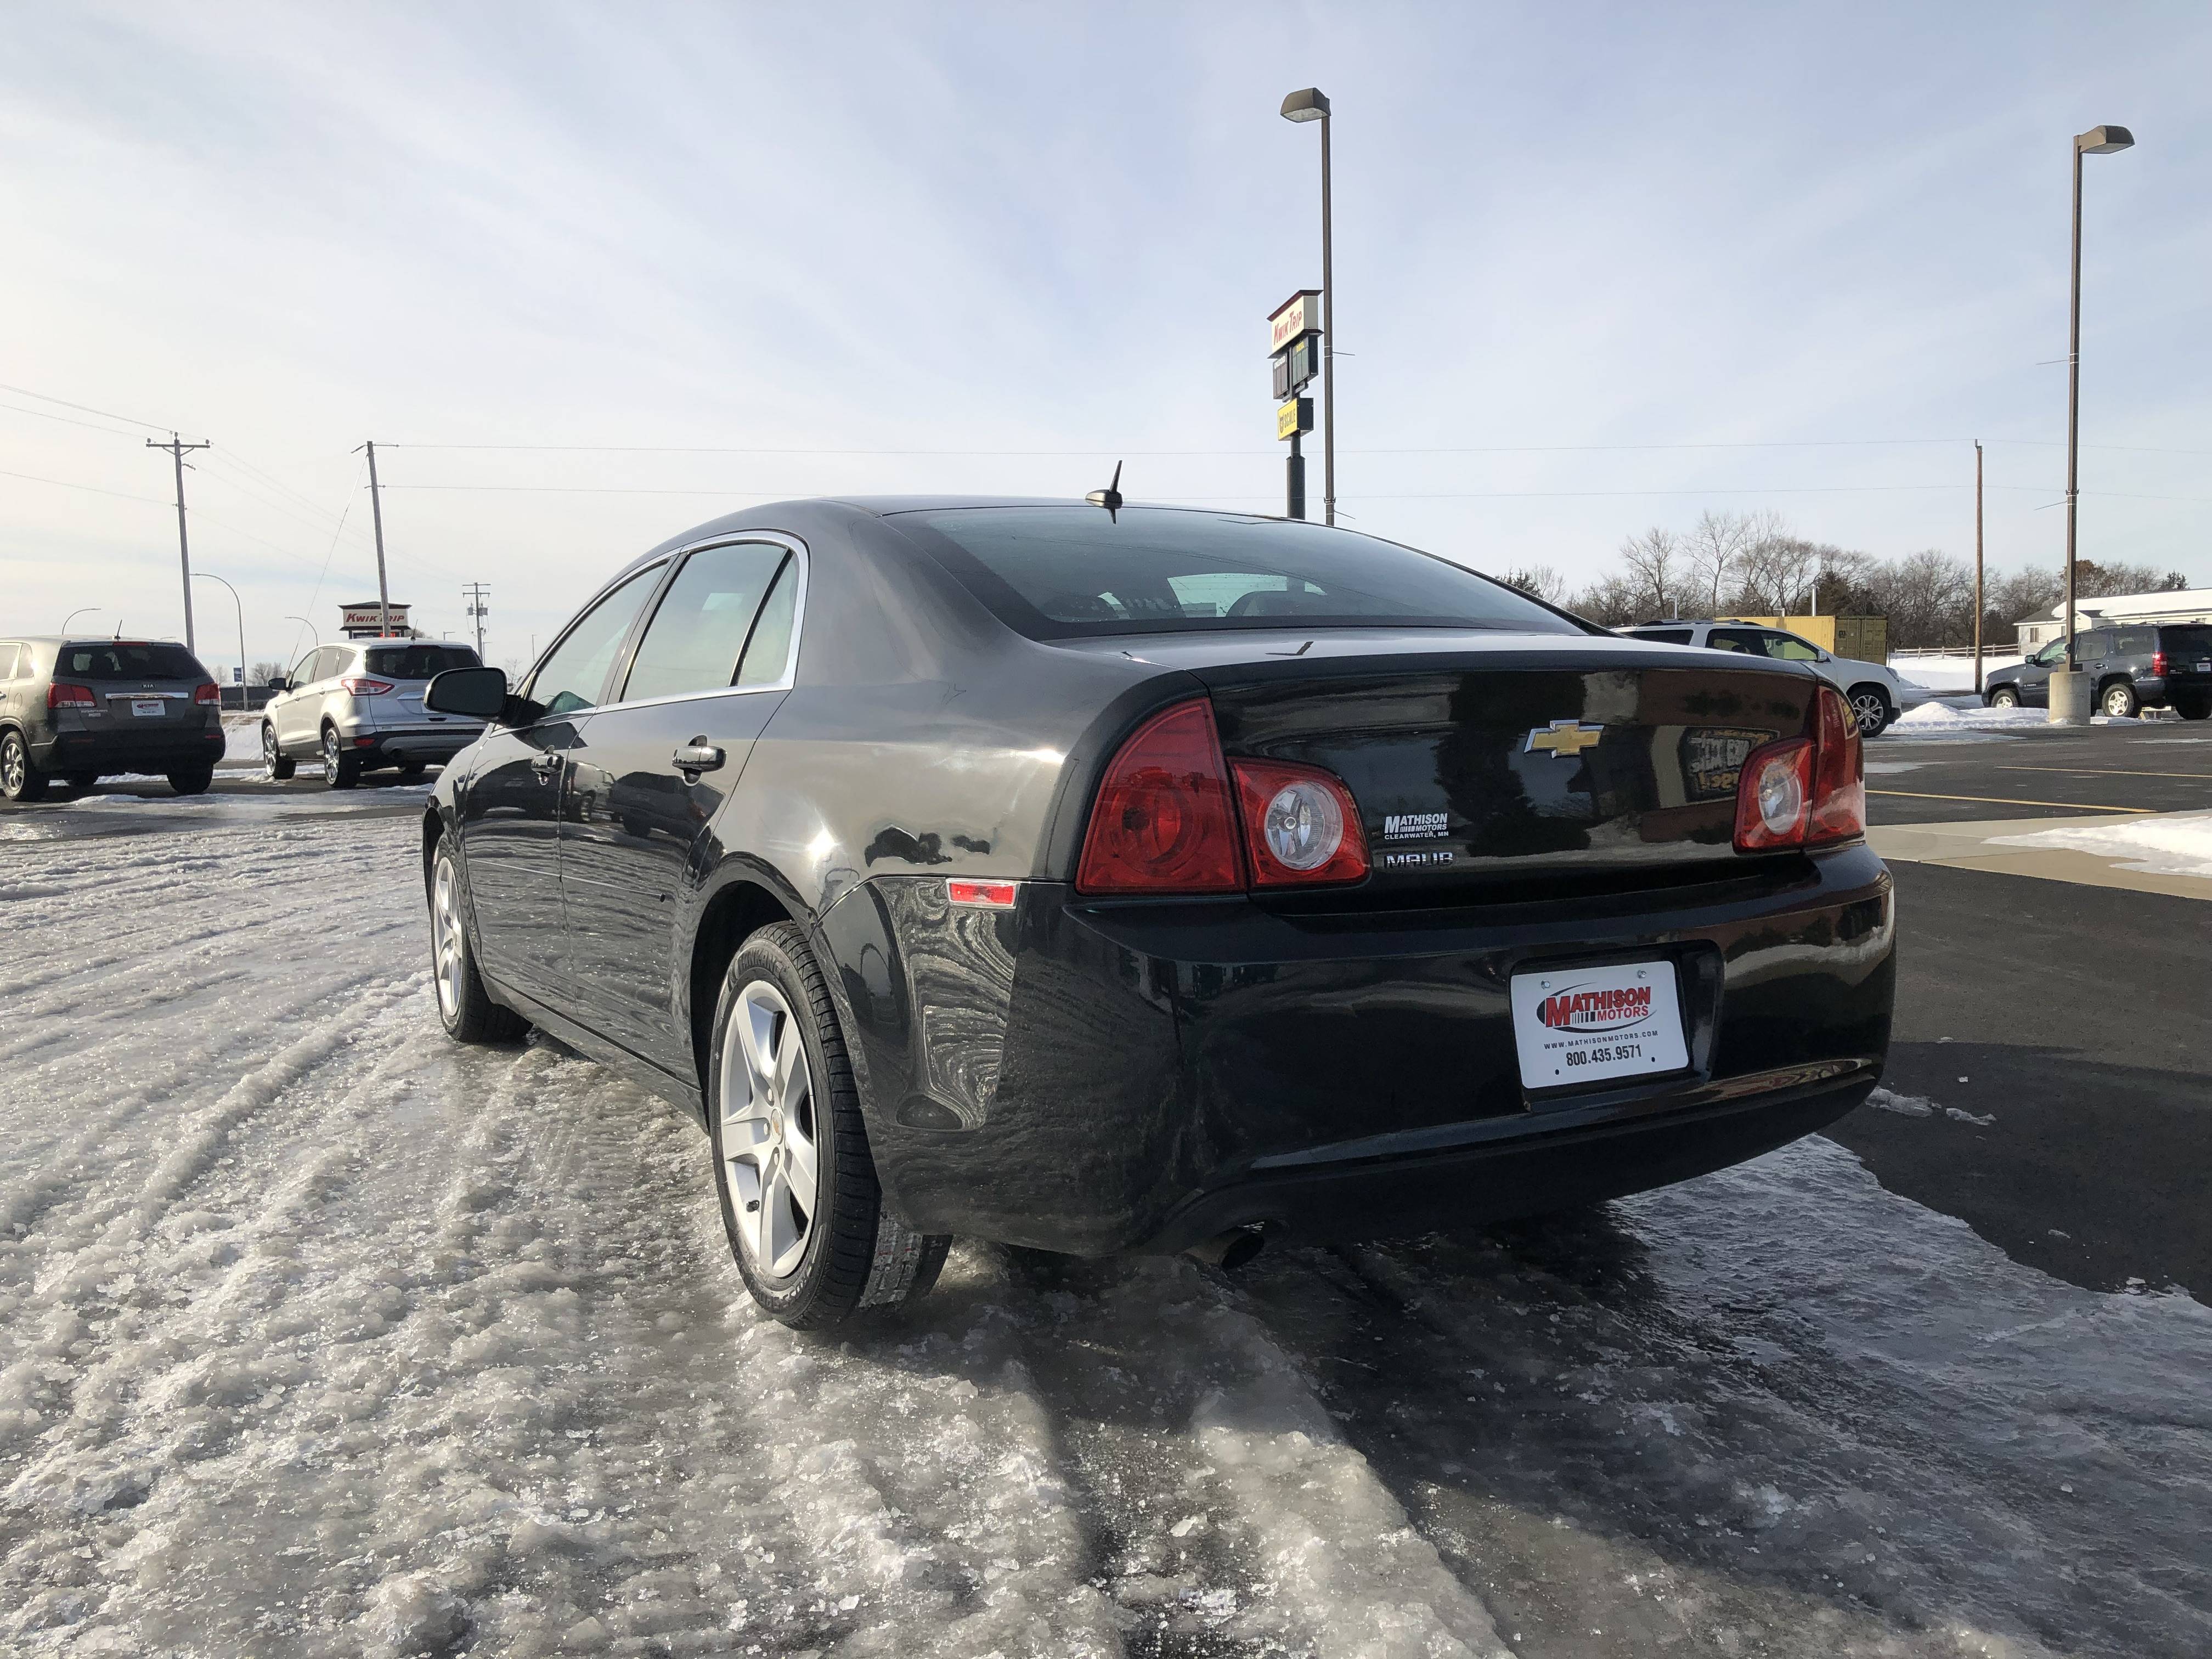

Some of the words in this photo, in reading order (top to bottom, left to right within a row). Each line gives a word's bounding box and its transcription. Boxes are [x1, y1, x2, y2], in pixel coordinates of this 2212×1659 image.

[1273, 320, 1289, 345] KWIK
[1289, 309, 1302, 333] TRIP
[346, 613, 377, 622] KWIK
[379, 613, 405, 622] RIP
[1384, 813, 1448, 833] MATHISON
[1415, 824, 1447, 832] MOTORS
[1545, 986, 1651, 1028] MATHISON
[1597, 1006, 1649, 1021] MOTORS
[1544, 1030, 1658, 1049] WWW.MATHISONMOTORS.COM
[1566, 1045, 1642, 1066] 800.435.9571
